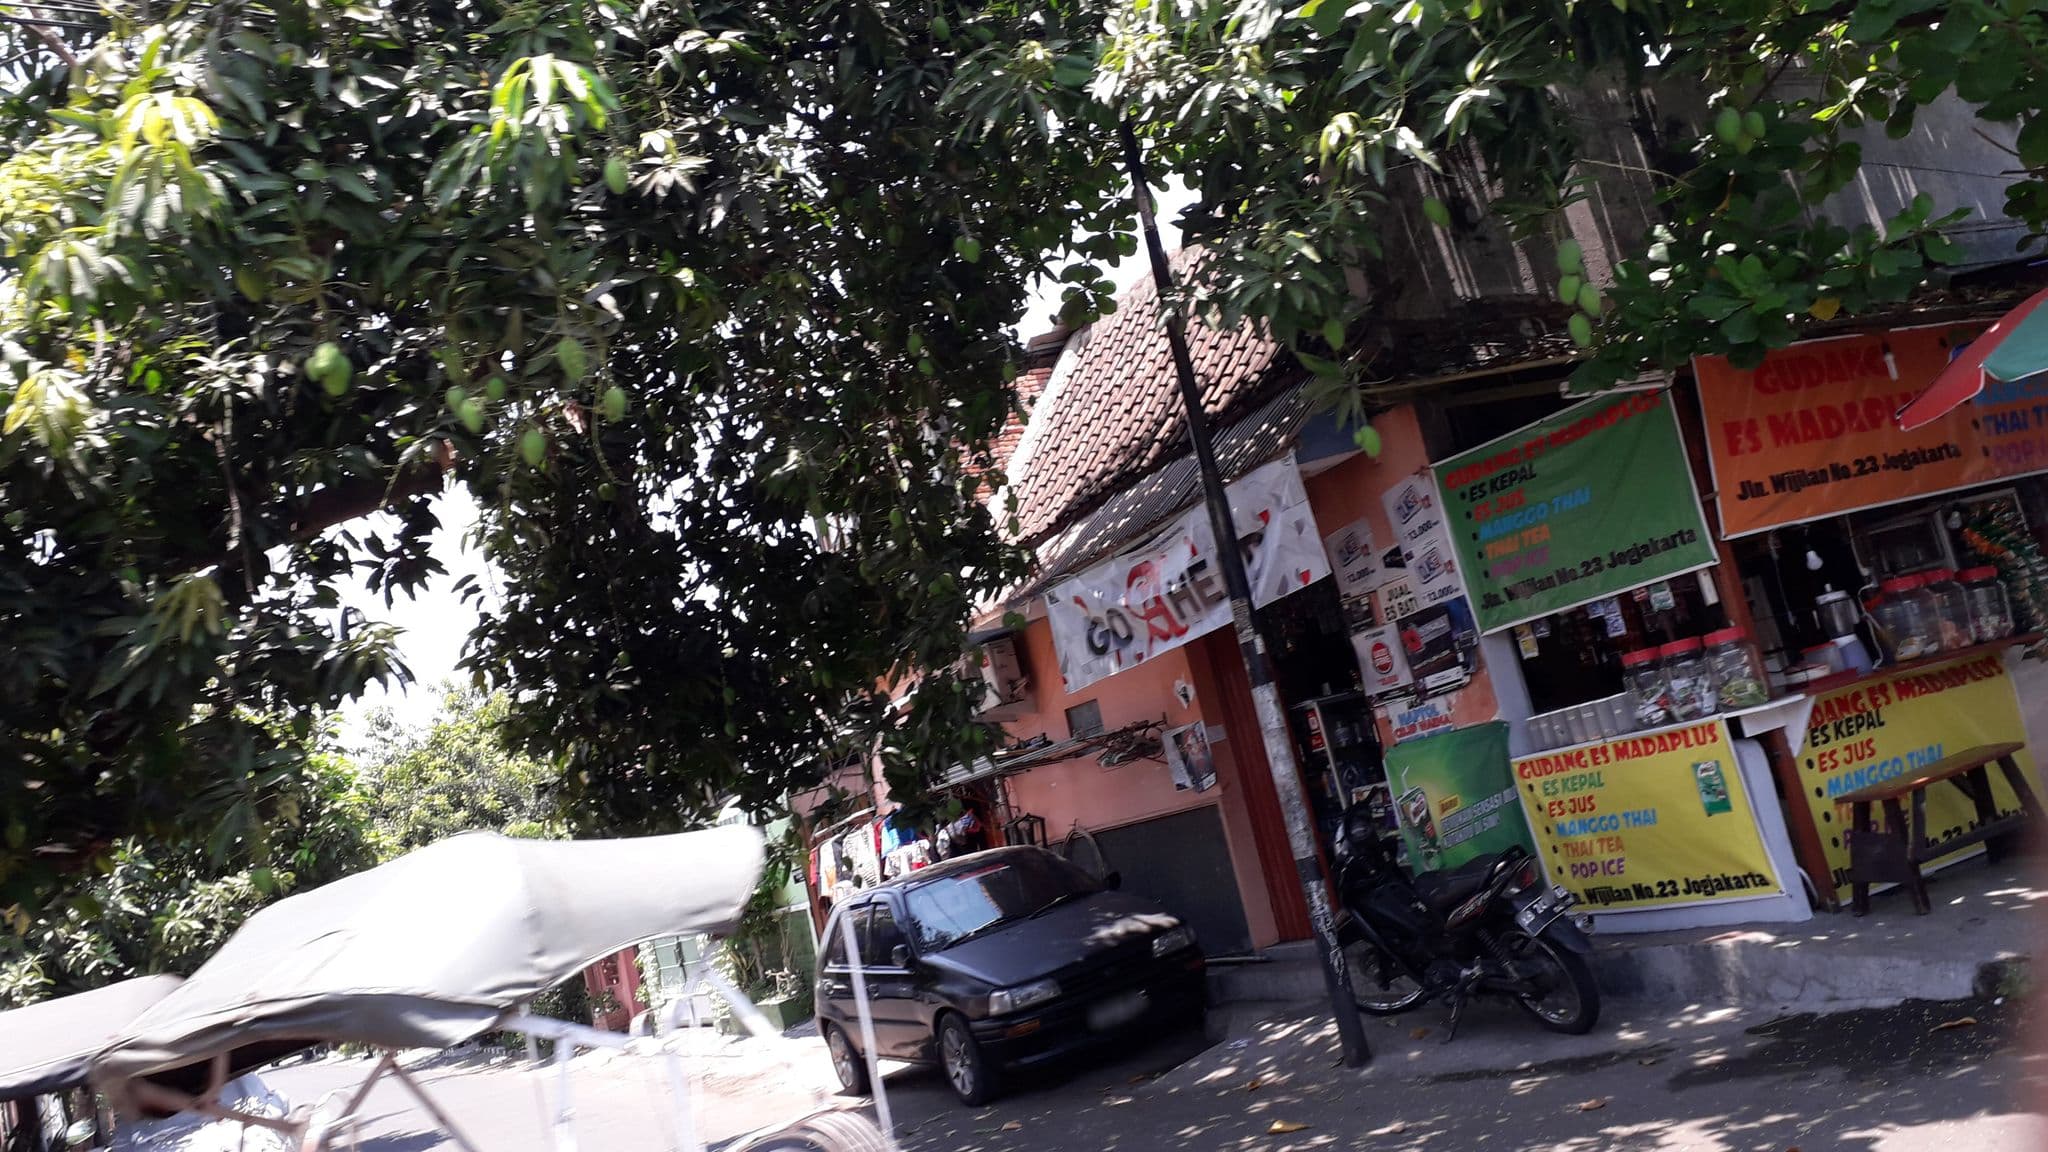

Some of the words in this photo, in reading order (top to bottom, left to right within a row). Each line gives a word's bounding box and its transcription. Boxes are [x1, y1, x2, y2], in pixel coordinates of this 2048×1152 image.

[1723, 417, 1762, 457] ES
[1882, 443, 1961, 472] Jogjakarta
[1469, 477, 1486, 503] ES
[1490, 463, 1538, 492] KEPAL
[1474, 500, 1492, 522] ES
[1607, 527, 1697, 569] Jogjakarta
[1808, 691, 1866, 728] DANG
[1868, 682, 1892, 709] ES
[1810, 727, 1831, 747] ES
[1834, 709, 1885, 740] KEPAL
[1518, 749, 1589, 779] GUDANG
[1591, 744, 1611, 767] ES
[1614, 722, 1720, 762] MADAPLUS
[1818, 751, 1840, 773] ES
[1843, 737, 1876, 765] JUS
[1906, 743, 1944, 770] THAI
[1542, 778, 1561, 797] ES
[1562, 770, 1605, 796] KEPAL
[1548, 799, 1566, 818] ES
[1568, 794, 1597, 815] JUS
[1556, 815, 1620, 838] MANGGO
[1622, 808, 1658, 828] THAI
[1563, 841, 1594, 858] THAI
[1597, 836, 1625, 854] TEA
[1571, 860, 1599, 880] POP
[1601, 857, 1626, 877] ICE
[1634, 880, 1680, 902] No.23
[1682, 871, 1771, 896] Jogjakarta
